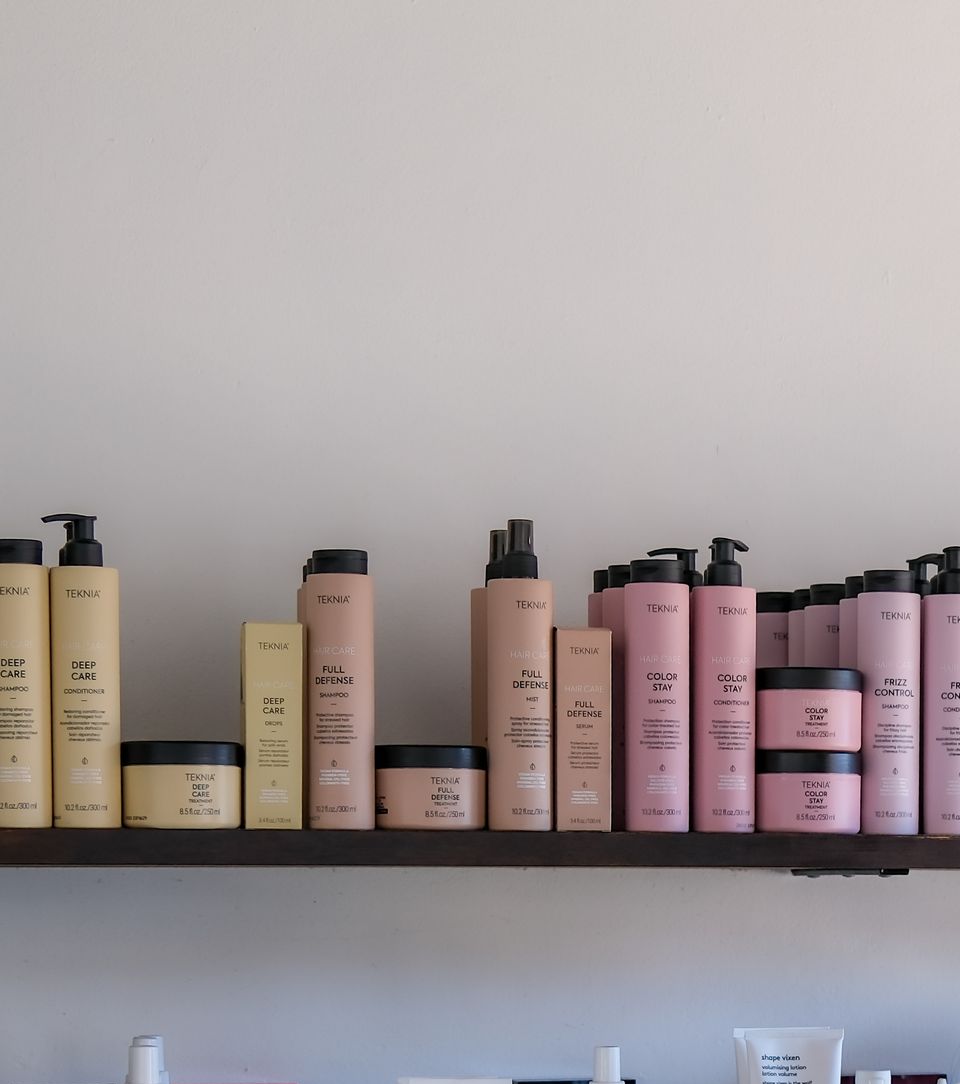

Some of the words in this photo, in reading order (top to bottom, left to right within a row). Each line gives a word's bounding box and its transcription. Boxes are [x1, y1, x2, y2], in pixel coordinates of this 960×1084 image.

[0, 587, 30, 595] EKNIA
[1, 659, 25, 667] DEEP
[72, 661, 96, 669] DEEP
[1, 669, 25, 678] CARE
[322, 666, 344, 674] FULL
[522, 670, 542, 678] FULL
[71, 672, 96, 680] CARE
[647, 673, 678, 681] COLOR
[717, 674, 747, 682] COLOR
[315, 677, 353, 685] DEFENSE
[512, 680, 549, 689] DEFENSE
[723, 684, 742, 693] STAY
[874, 689, 914, 697] CONTROL
[567, 710, 602, 718] DEFENSE
[761, 1054, 780, 1062] shape
